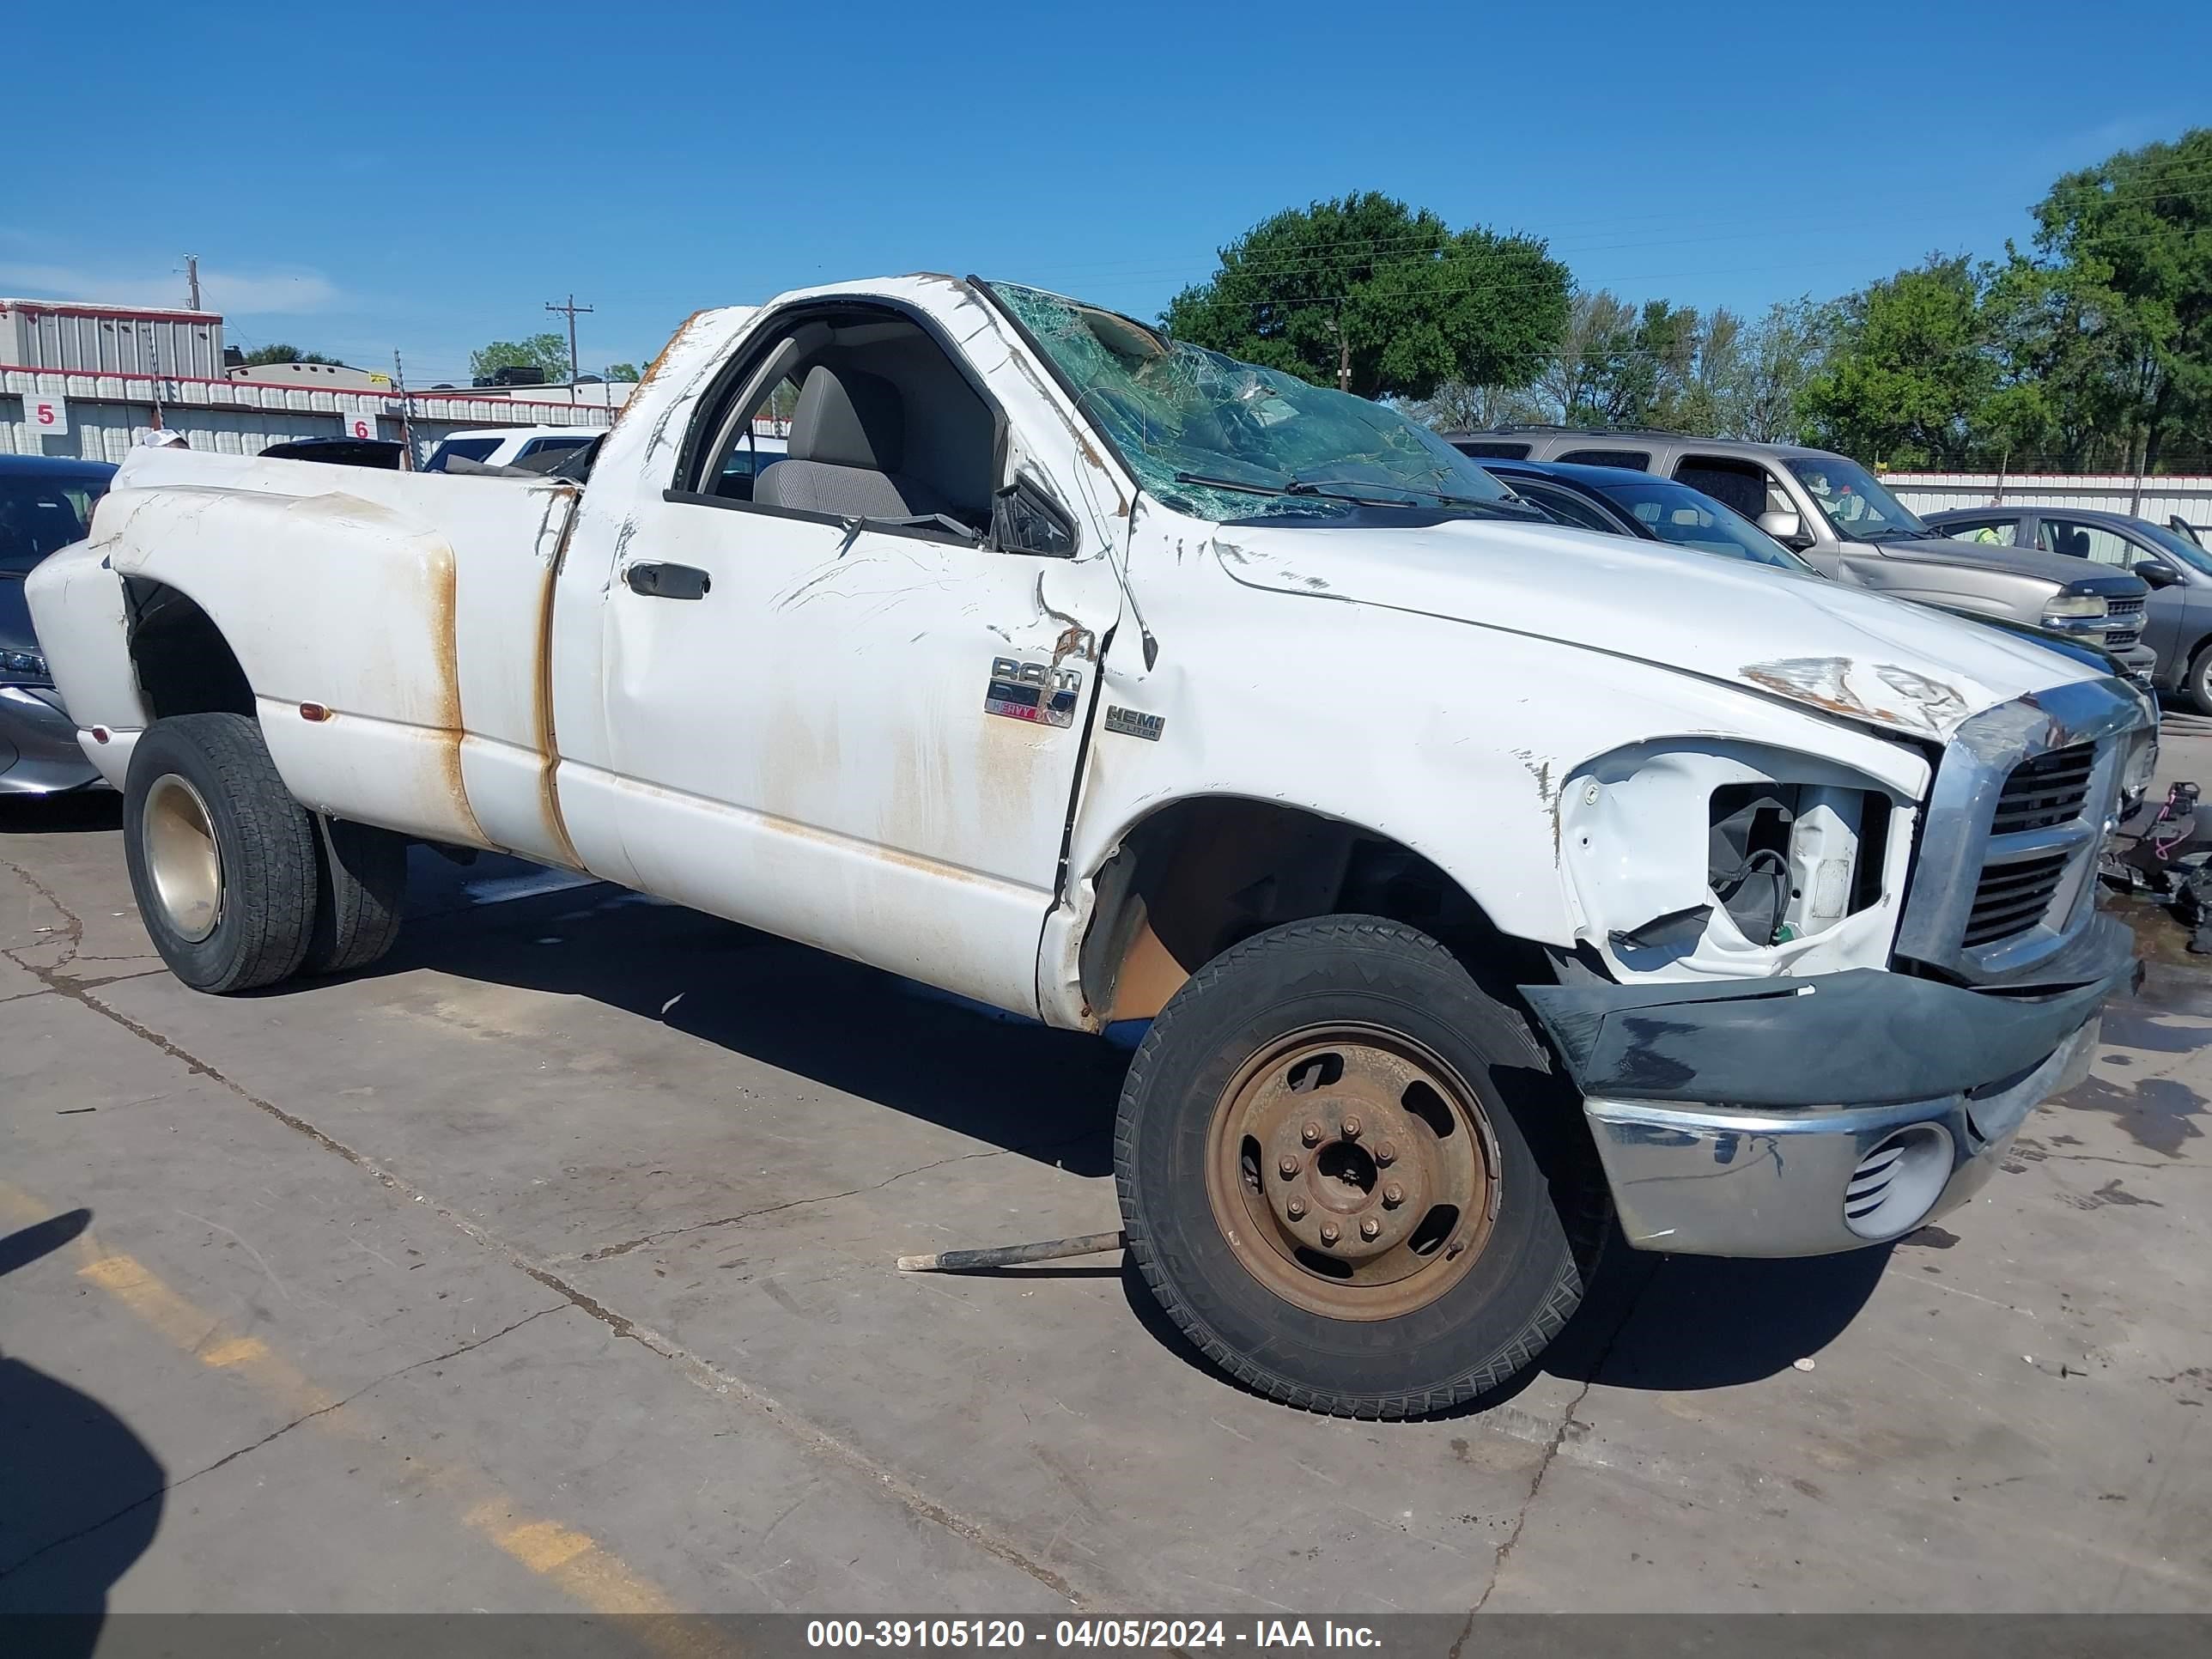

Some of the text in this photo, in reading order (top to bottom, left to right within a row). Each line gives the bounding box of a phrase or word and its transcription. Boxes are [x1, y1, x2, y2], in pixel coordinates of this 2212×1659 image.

[38, 404, 55, 424] 5
[355, 421, 368, 439] 6
[994, 700, 1031, 718] HEAVY
[1106, 705, 1165, 731] HEMI
[1106, 720, 1157, 738] 5.7 LITER
